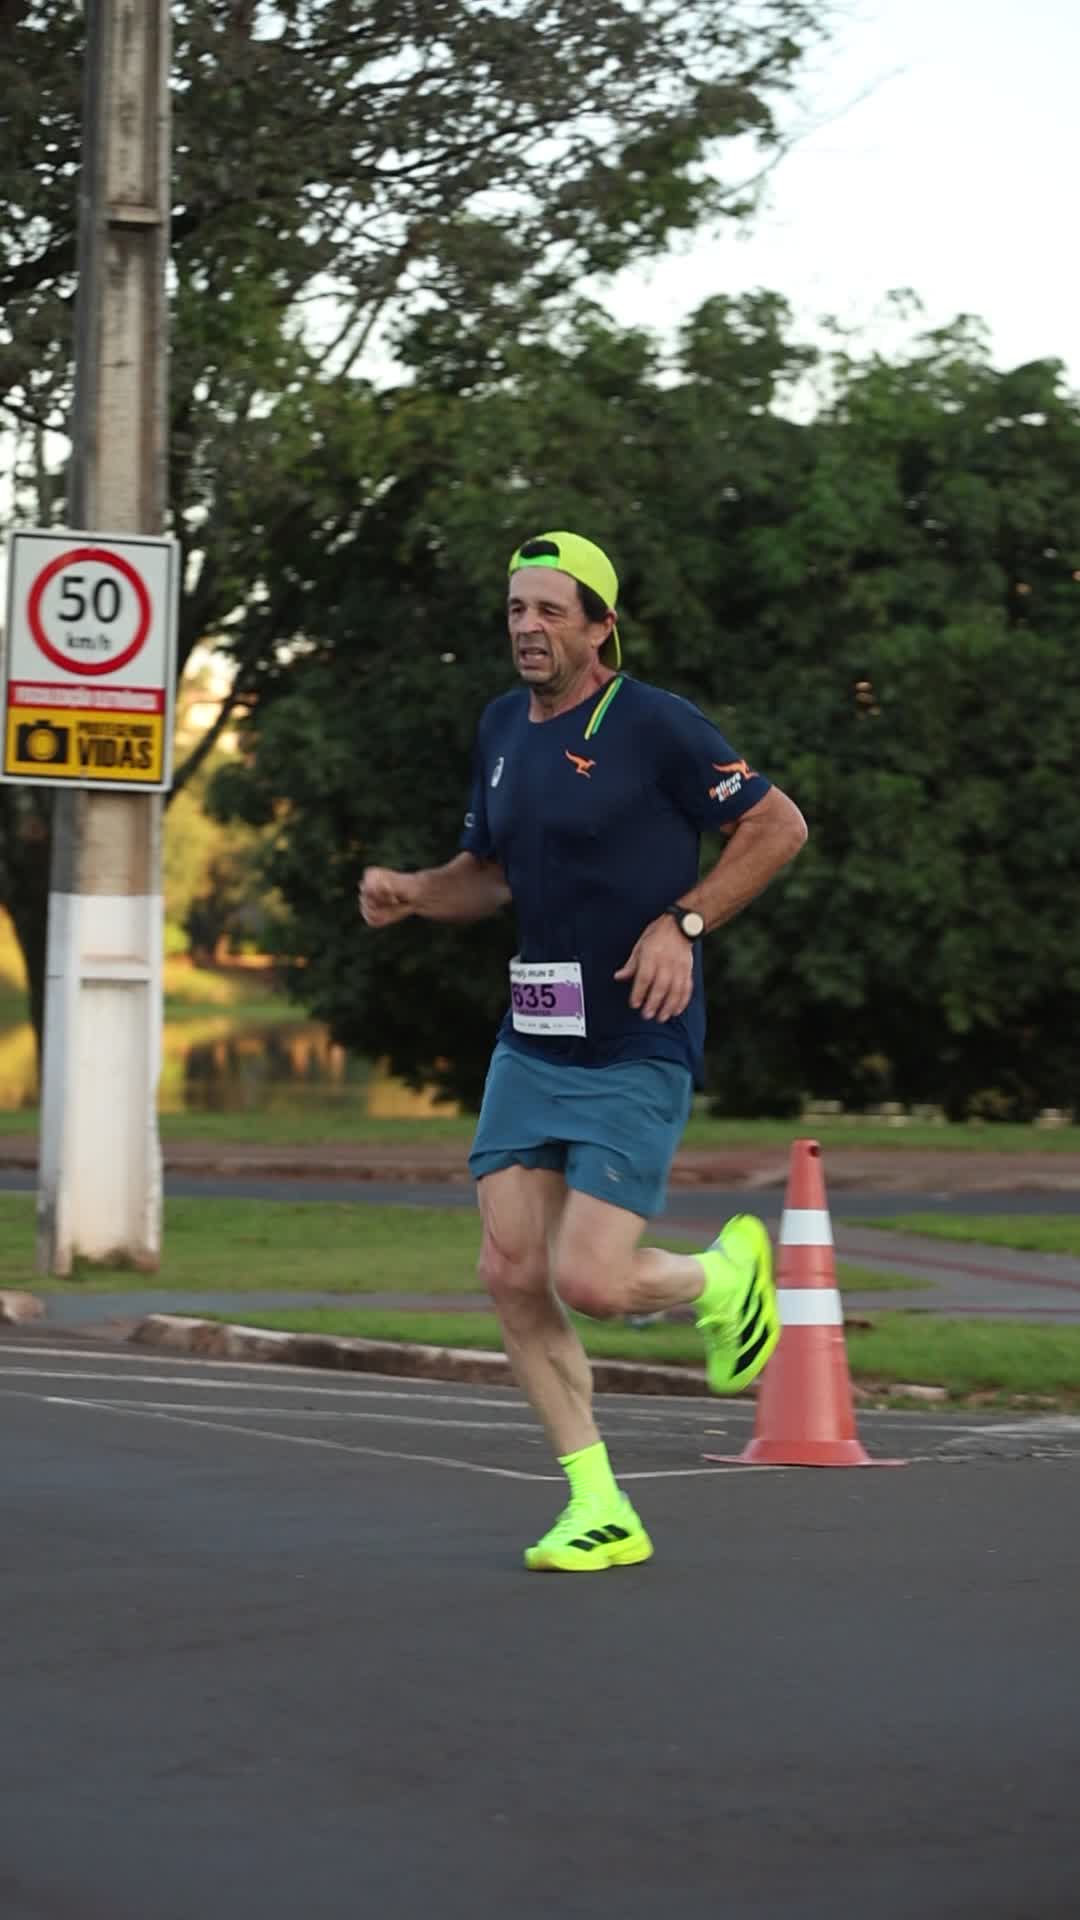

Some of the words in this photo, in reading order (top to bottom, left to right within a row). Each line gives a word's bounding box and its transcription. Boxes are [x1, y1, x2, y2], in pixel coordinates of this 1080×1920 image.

[58, 576, 122, 623] 50
[67, 633, 111, 650] km/h
[77, 737, 153, 769] VIDAS
